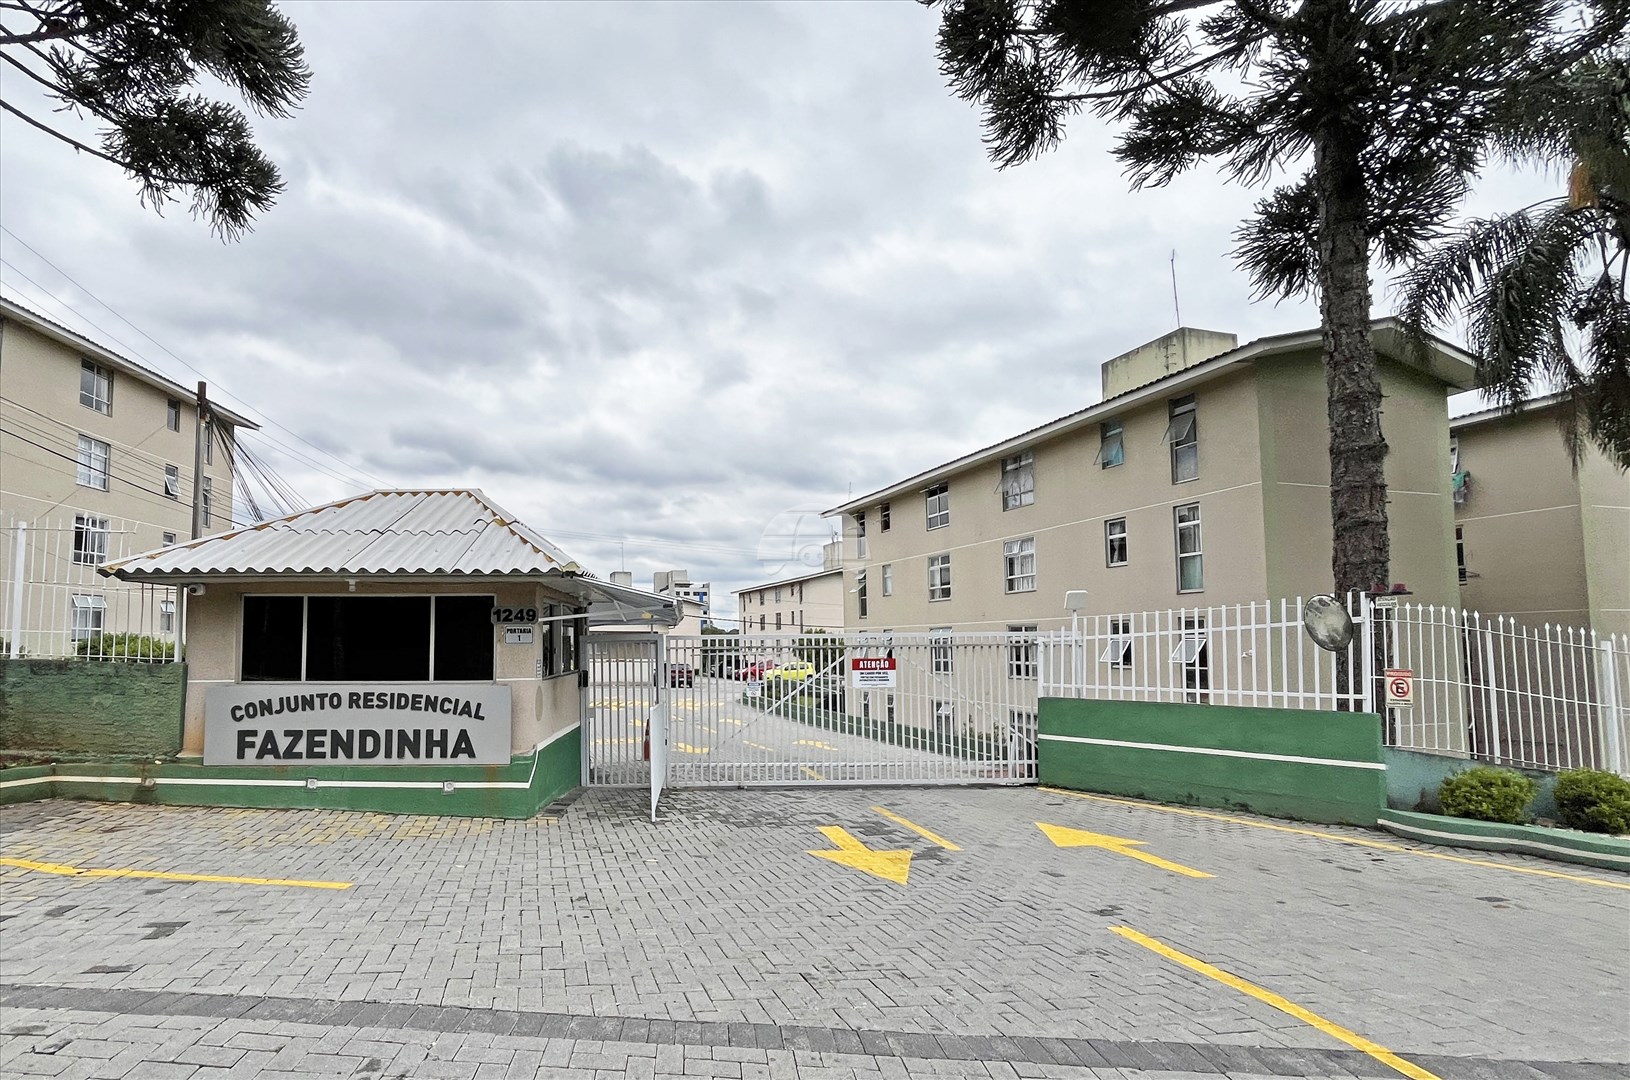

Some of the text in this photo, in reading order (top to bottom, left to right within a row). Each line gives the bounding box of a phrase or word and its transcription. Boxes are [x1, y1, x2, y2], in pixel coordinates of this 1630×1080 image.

[493, 608, 537, 622] 1249
[859, 659, 889, 670] ATENÇÃO
[231, 691, 485, 722] CONJUNTO RESIDENCIAL
[236, 728, 477, 760] FAZENDINHA
